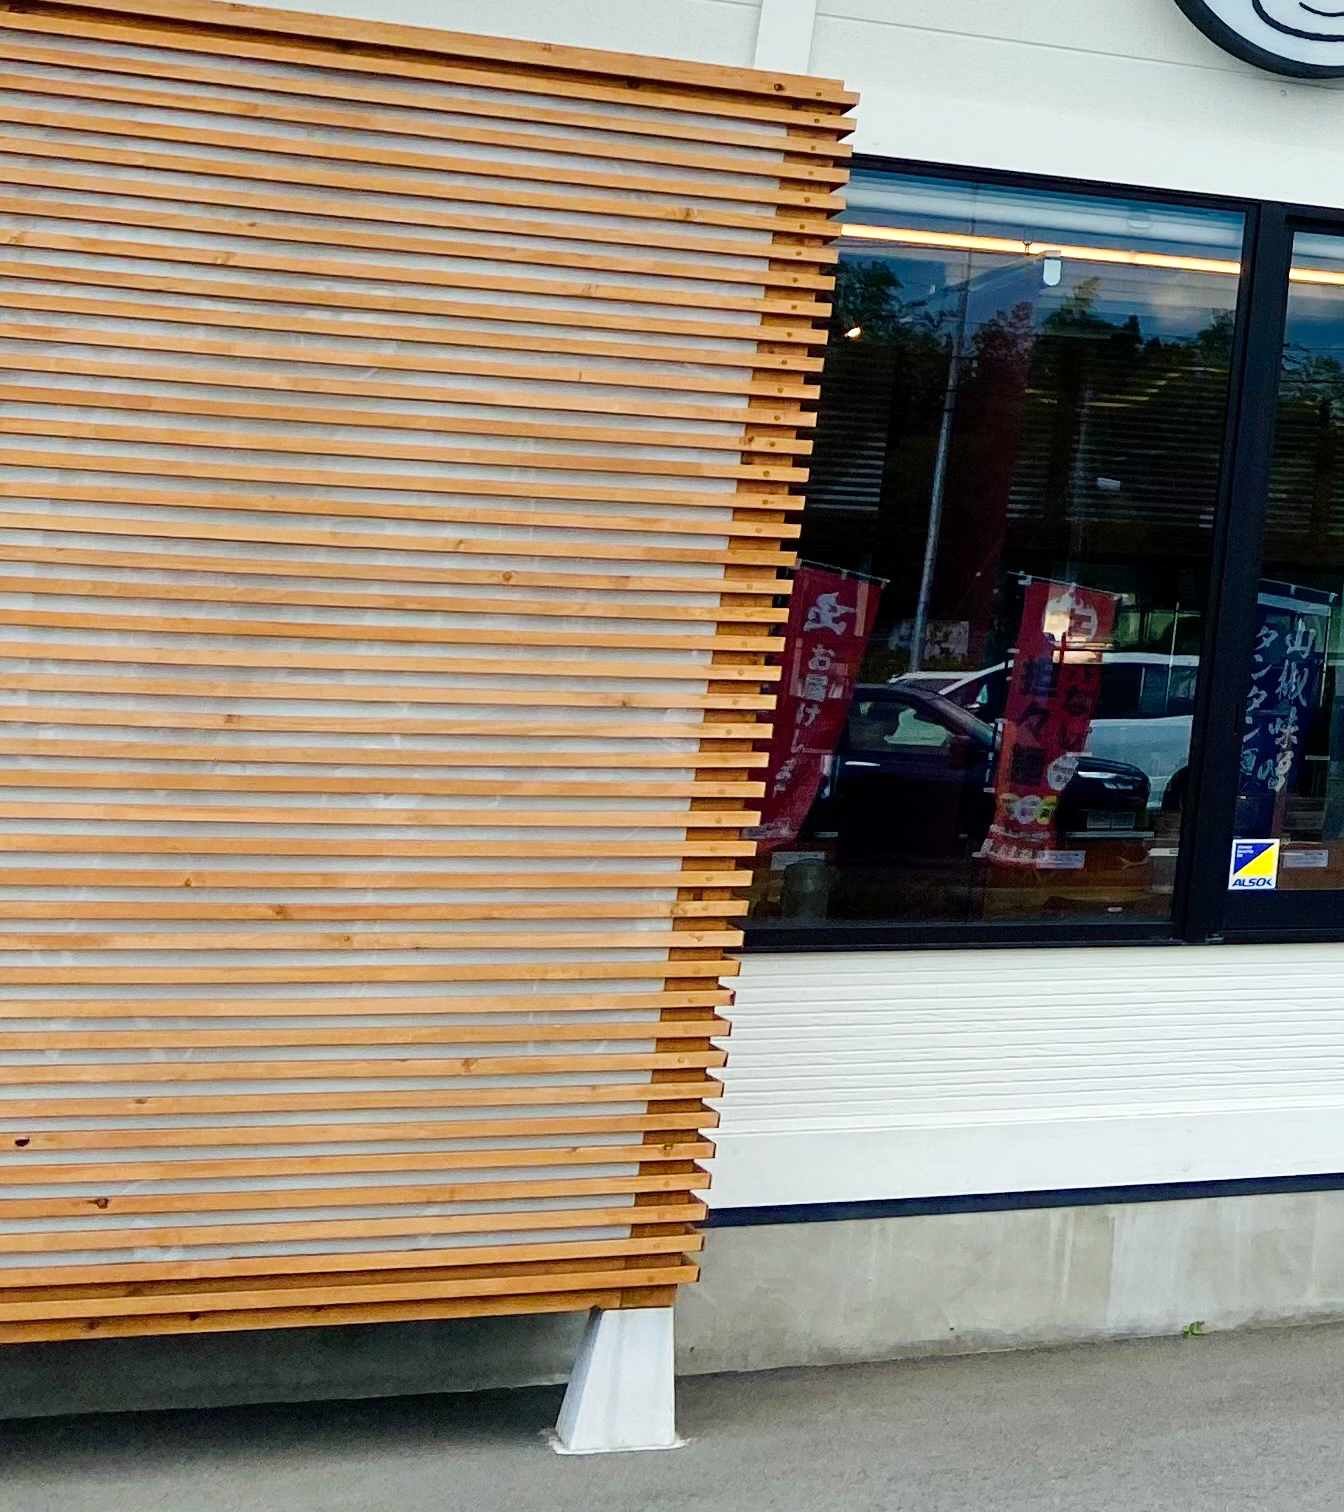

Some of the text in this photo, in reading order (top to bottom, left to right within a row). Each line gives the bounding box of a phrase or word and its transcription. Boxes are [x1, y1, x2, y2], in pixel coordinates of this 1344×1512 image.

[1257, 618, 1315, 792] 山椒味噌
[1232, 877, 1273, 887] ALSOK
